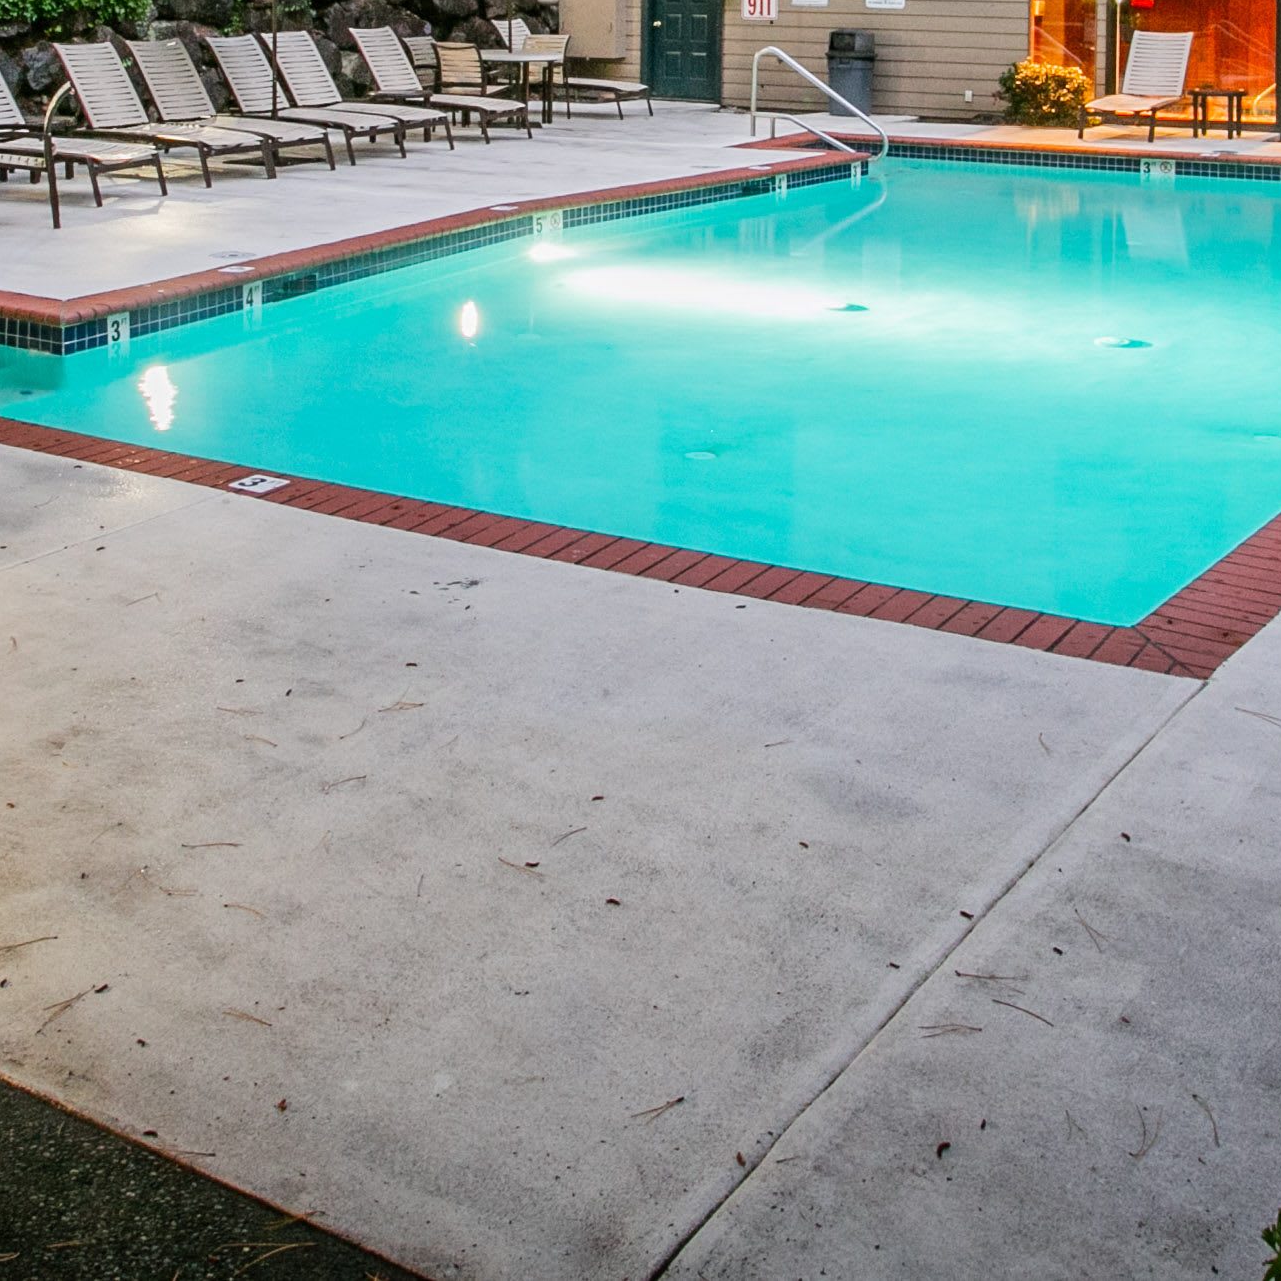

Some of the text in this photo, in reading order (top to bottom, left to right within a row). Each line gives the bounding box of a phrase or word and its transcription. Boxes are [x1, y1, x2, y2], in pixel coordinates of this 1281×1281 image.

[1143, 161, 1151, 173] 3
[536, 217, 543, 233] 5
[246, 286, 254, 307] 4
[111, 319, 121, 342] 3
[238, 477, 267, 487] 3
